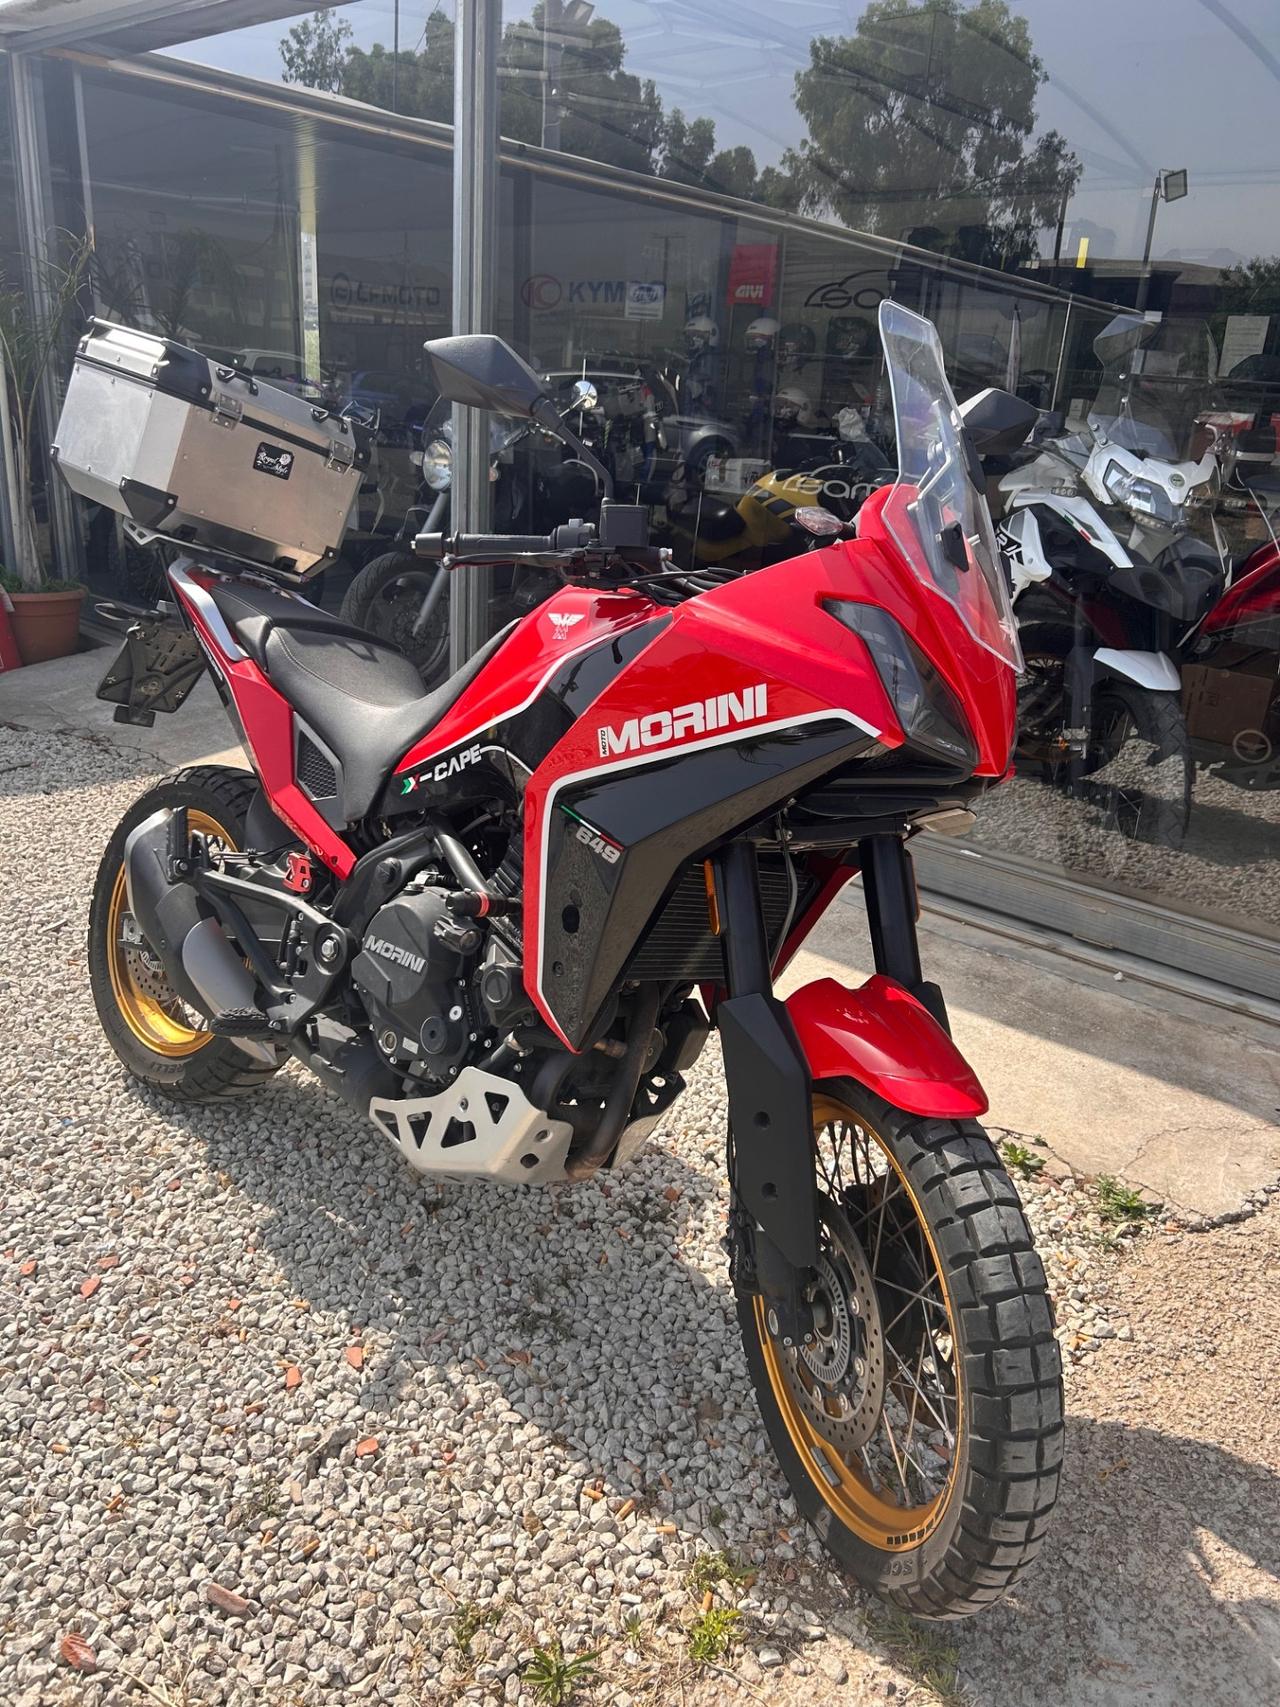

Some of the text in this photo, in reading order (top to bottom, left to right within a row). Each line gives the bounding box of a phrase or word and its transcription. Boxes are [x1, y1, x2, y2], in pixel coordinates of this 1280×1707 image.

[569, 280, 667, 304] KYM
[608, 683, 767, 755] MORINI
[401, 744, 481, 795] X-CAPE
[576, 826, 620, 864] 649
[365, 935, 427, 973] MORINI
